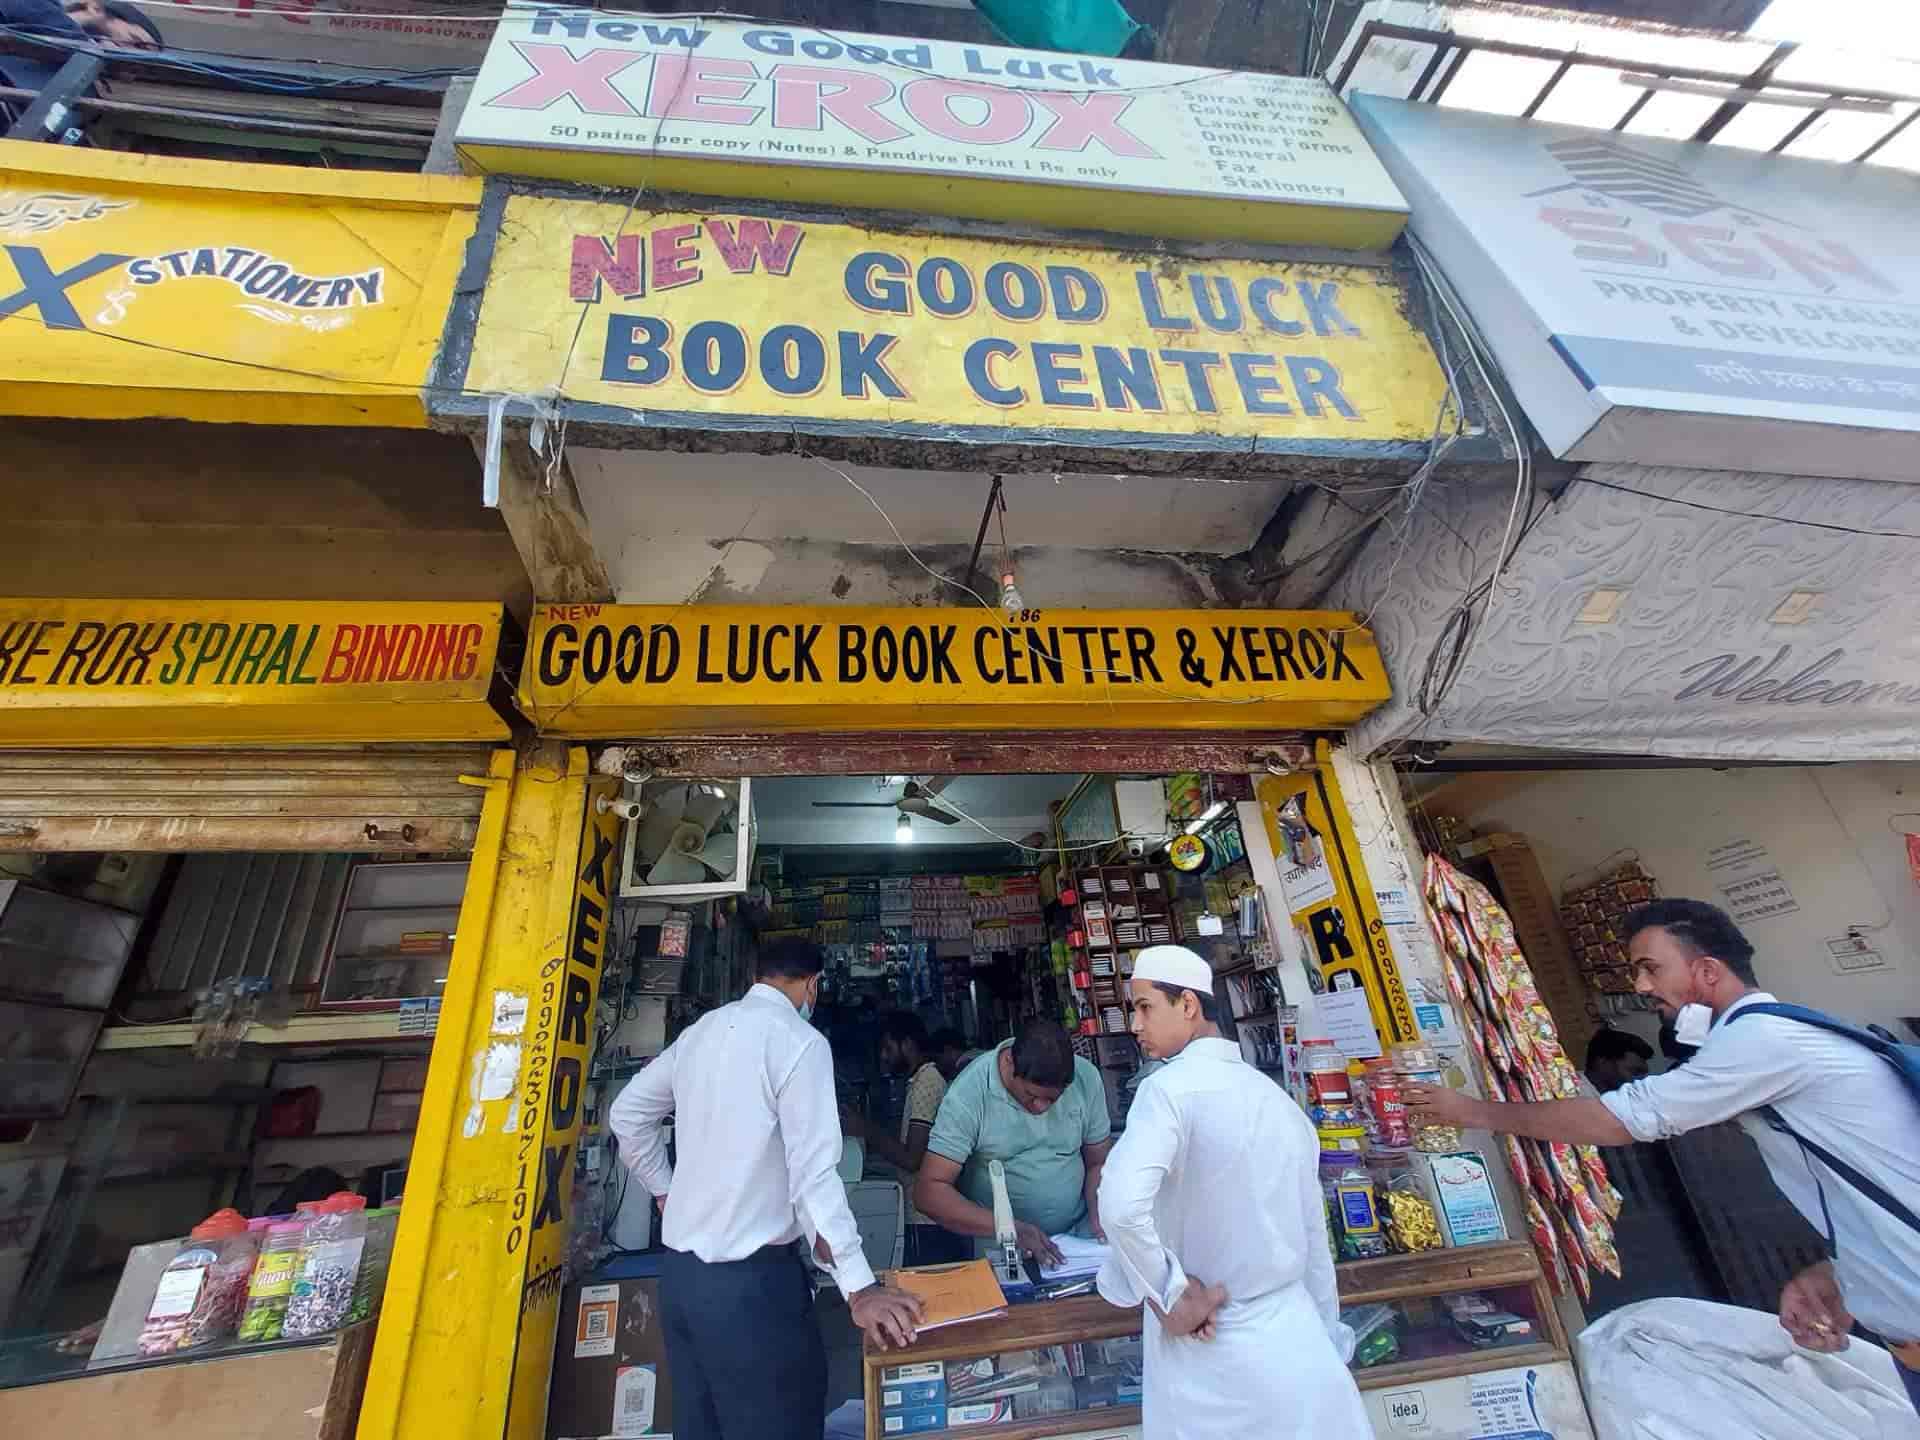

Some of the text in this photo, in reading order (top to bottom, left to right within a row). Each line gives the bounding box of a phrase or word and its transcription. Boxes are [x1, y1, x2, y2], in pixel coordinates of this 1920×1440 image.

[530, 10, 710, 48] New
[742, 30, 932, 70] Good
[963, 48, 1121, 88] Luck
[480, 40, 1167, 160] XEROX
[1181, 89, 1339, 116] Spiral Binding
[1189, 103, 1331, 126] Colour Xerox
[1194, 116, 1323, 138] Lamination
[550, 124, 579, 138] 50
[586, 128, 647, 143] paise
[656, 132, 692, 147] per
[700, 136, 751, 151] copy
[843, 145, 858, 157] &
[965, 155, 1015, 170] Print
[1077, 166, 1119, 180] only
[1201, 130, 1353, 155] Online Forms
[1208, 145, 1297, 162] General
[1216, 160, 1258, 174] Fax
[127, 247, 386, 311] STATIONERY
[570, 216, 808, 303] NEW
[844, 250, 1364, 339] GOOD LUCK
[1593, 278, 1785, 320] PROPERTY
[1669, 315, 1705, 337] &
[600, 312, 1362, 422] BOOK CENTER
[549, 604, 602, 621] NEW
[159, 622, 321, 686] SPIRAL
[538, 623, 1366, 688] GOOD LUCK BOOK CENTER & XEROX
[533, 818, 615, 1231] XEROX
